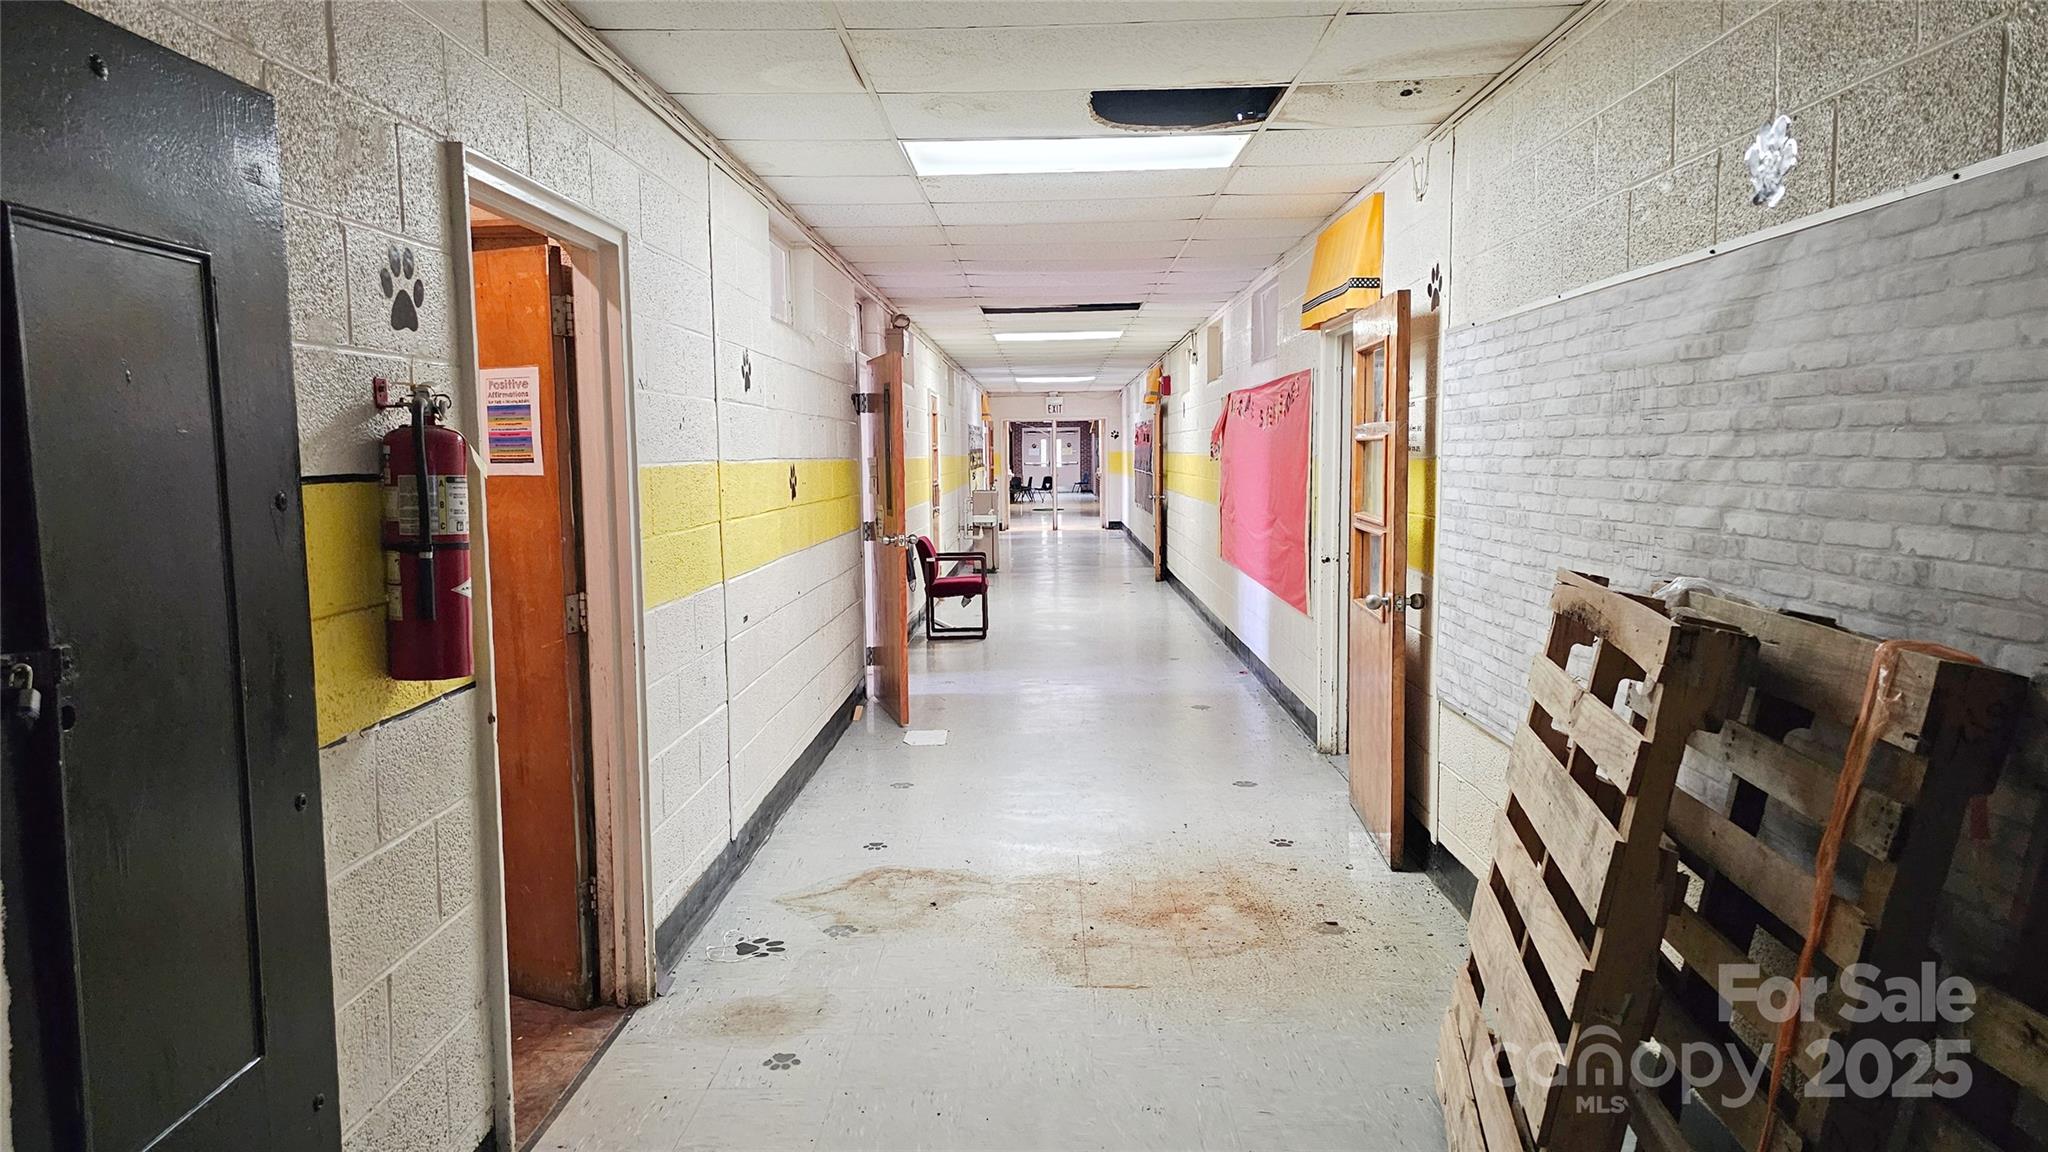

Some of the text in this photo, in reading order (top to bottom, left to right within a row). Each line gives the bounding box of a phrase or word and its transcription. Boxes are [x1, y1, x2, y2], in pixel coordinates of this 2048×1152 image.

[488, 379, 529, 390] Positive
[488, 391, 529, 399] Affirmations
[1047, 404, 1062, 414] EXIT
